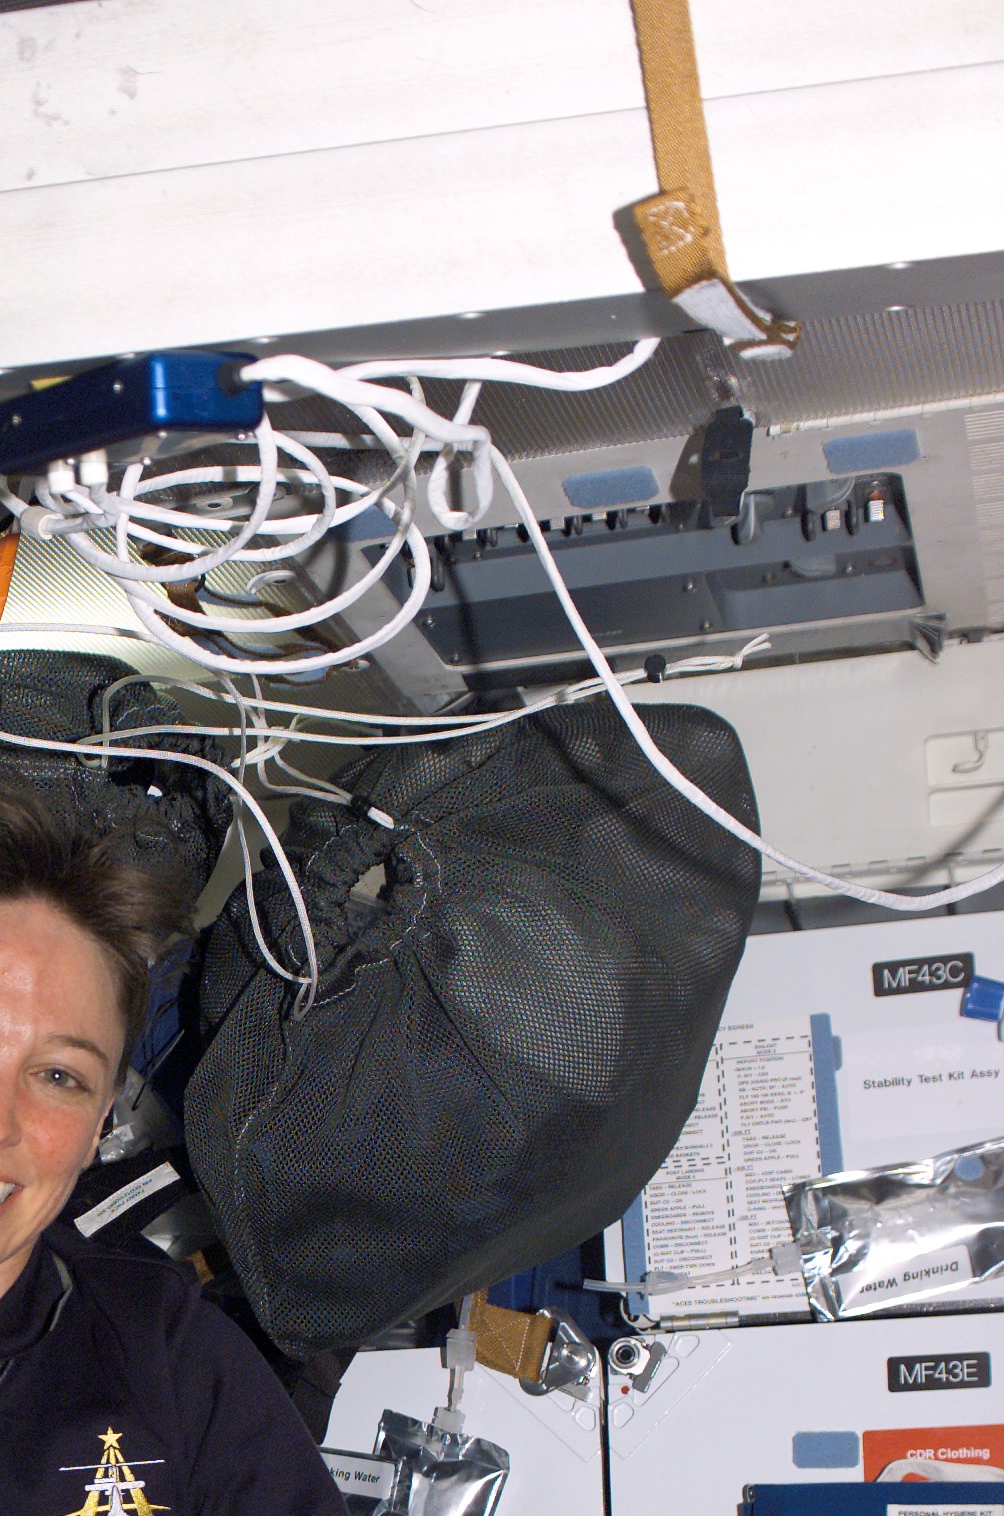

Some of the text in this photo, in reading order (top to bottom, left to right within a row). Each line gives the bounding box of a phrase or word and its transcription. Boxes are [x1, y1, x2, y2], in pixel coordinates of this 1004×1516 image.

[882, 961, 965, 990] MF43C
[863, 1068, 1000, 1090] Stability Test Kit Assy
[860, 1261, 959, 1294] Drinking Water
[899, 1360, 979, 1384] MF43E
[907, 1447, 991, 1460] CDR Clothing
[328, 1466, 381, 1484] king Water
